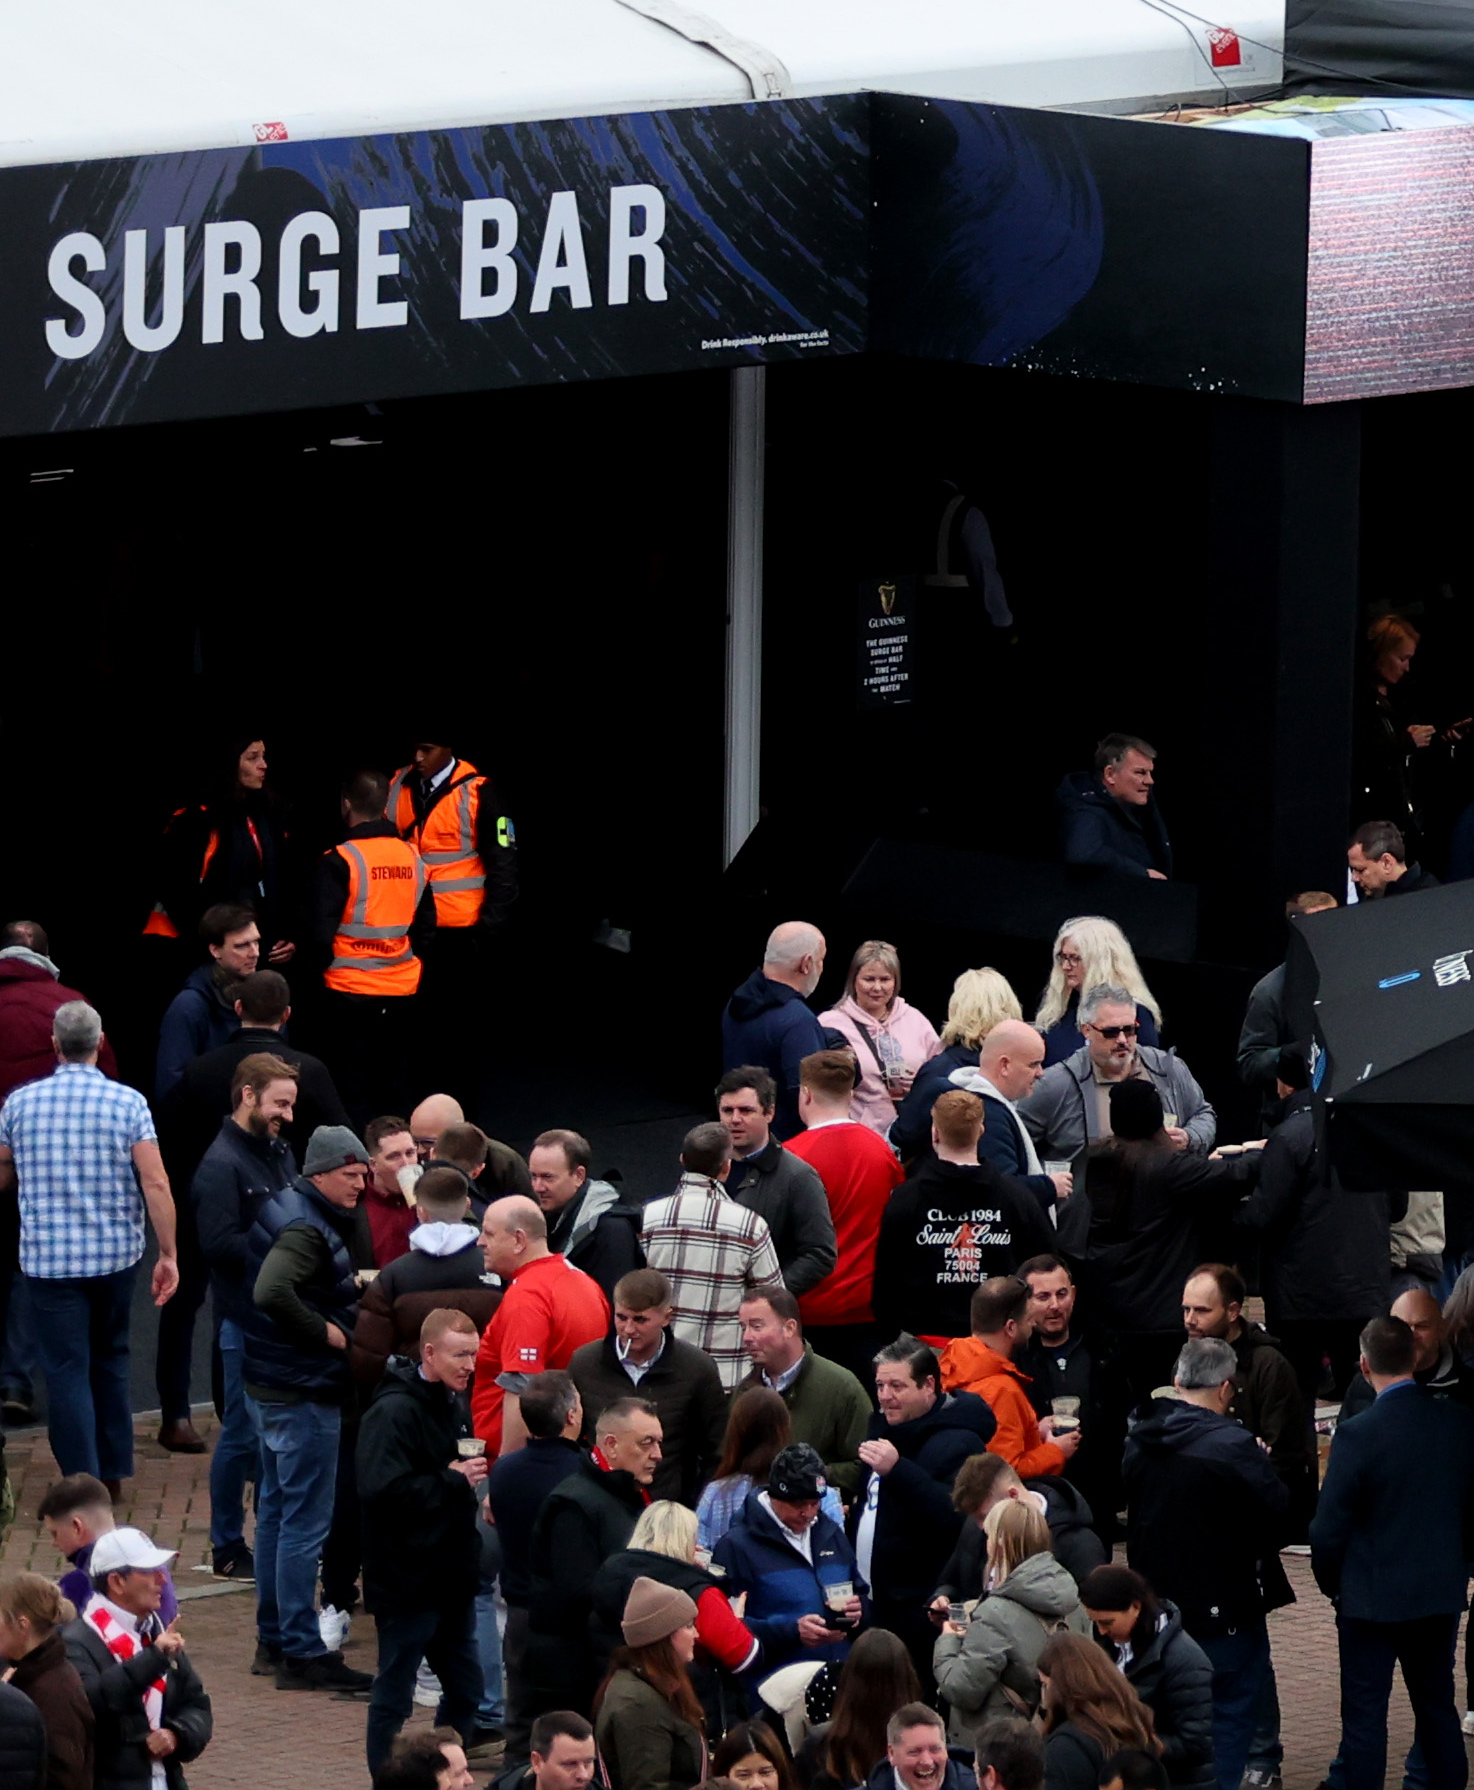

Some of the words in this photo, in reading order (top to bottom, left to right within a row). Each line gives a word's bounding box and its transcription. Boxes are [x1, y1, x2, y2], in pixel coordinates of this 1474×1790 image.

[45, 205, 412, 363] SURGE
[458, 183, 668, 321] BAR
[701, 339, 721, 350] Drink
[868, 616, 906, 629] GUINNESS
[371, 866, 413, 880] STEWARD
[970, 1209, 1002, 1222] 1984
[916, 1224, 961, 1245] Saint
[967, 1223, 1011, 1245] Louis
[944, 1247, 983, 1259] PARIS
[945, 1260, 981, 1271] 75004
[937, 1272, 988, 1283] FRANCE
